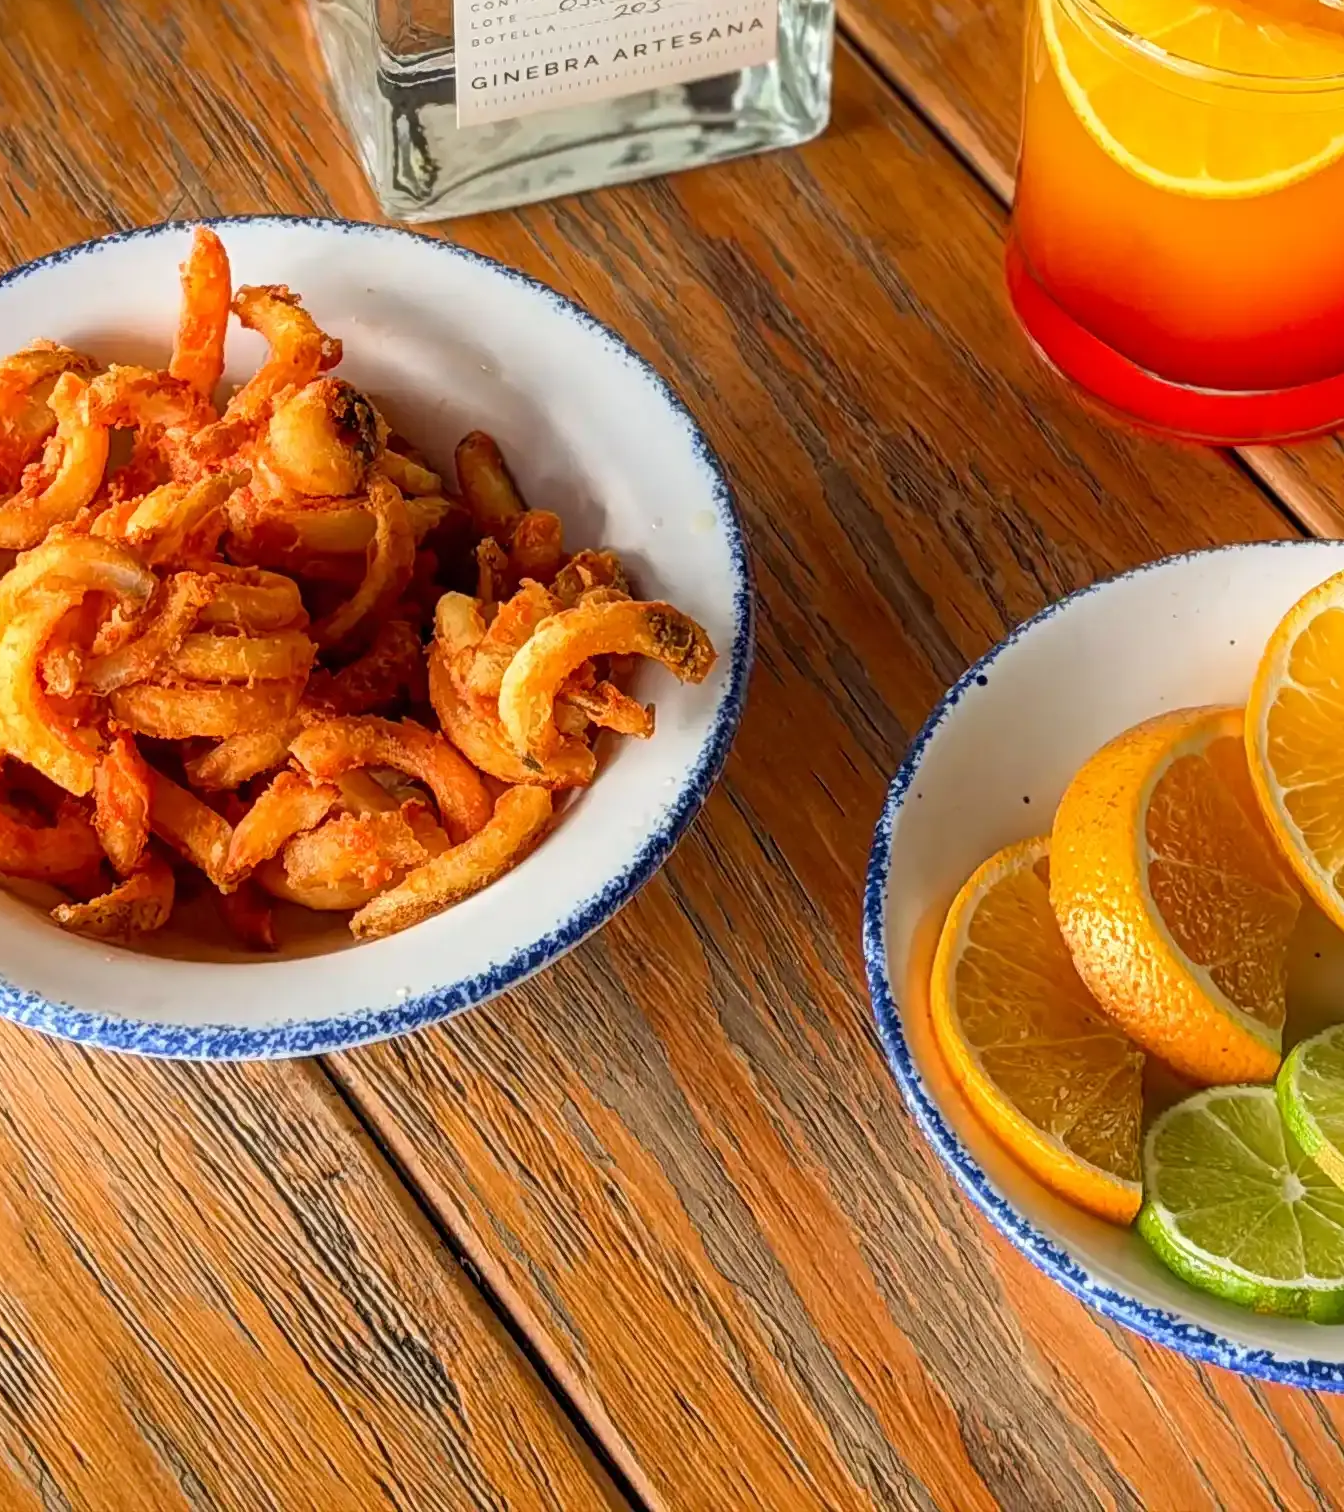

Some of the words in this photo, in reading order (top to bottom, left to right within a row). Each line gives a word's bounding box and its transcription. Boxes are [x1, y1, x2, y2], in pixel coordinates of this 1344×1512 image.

[470, 15, 517, 30] LOTE
[471, 24, 556, 48] BOTELLA
[471, 54, 600, 91] GINEBRA
[613, 17, 764, 62] ARTESANA
